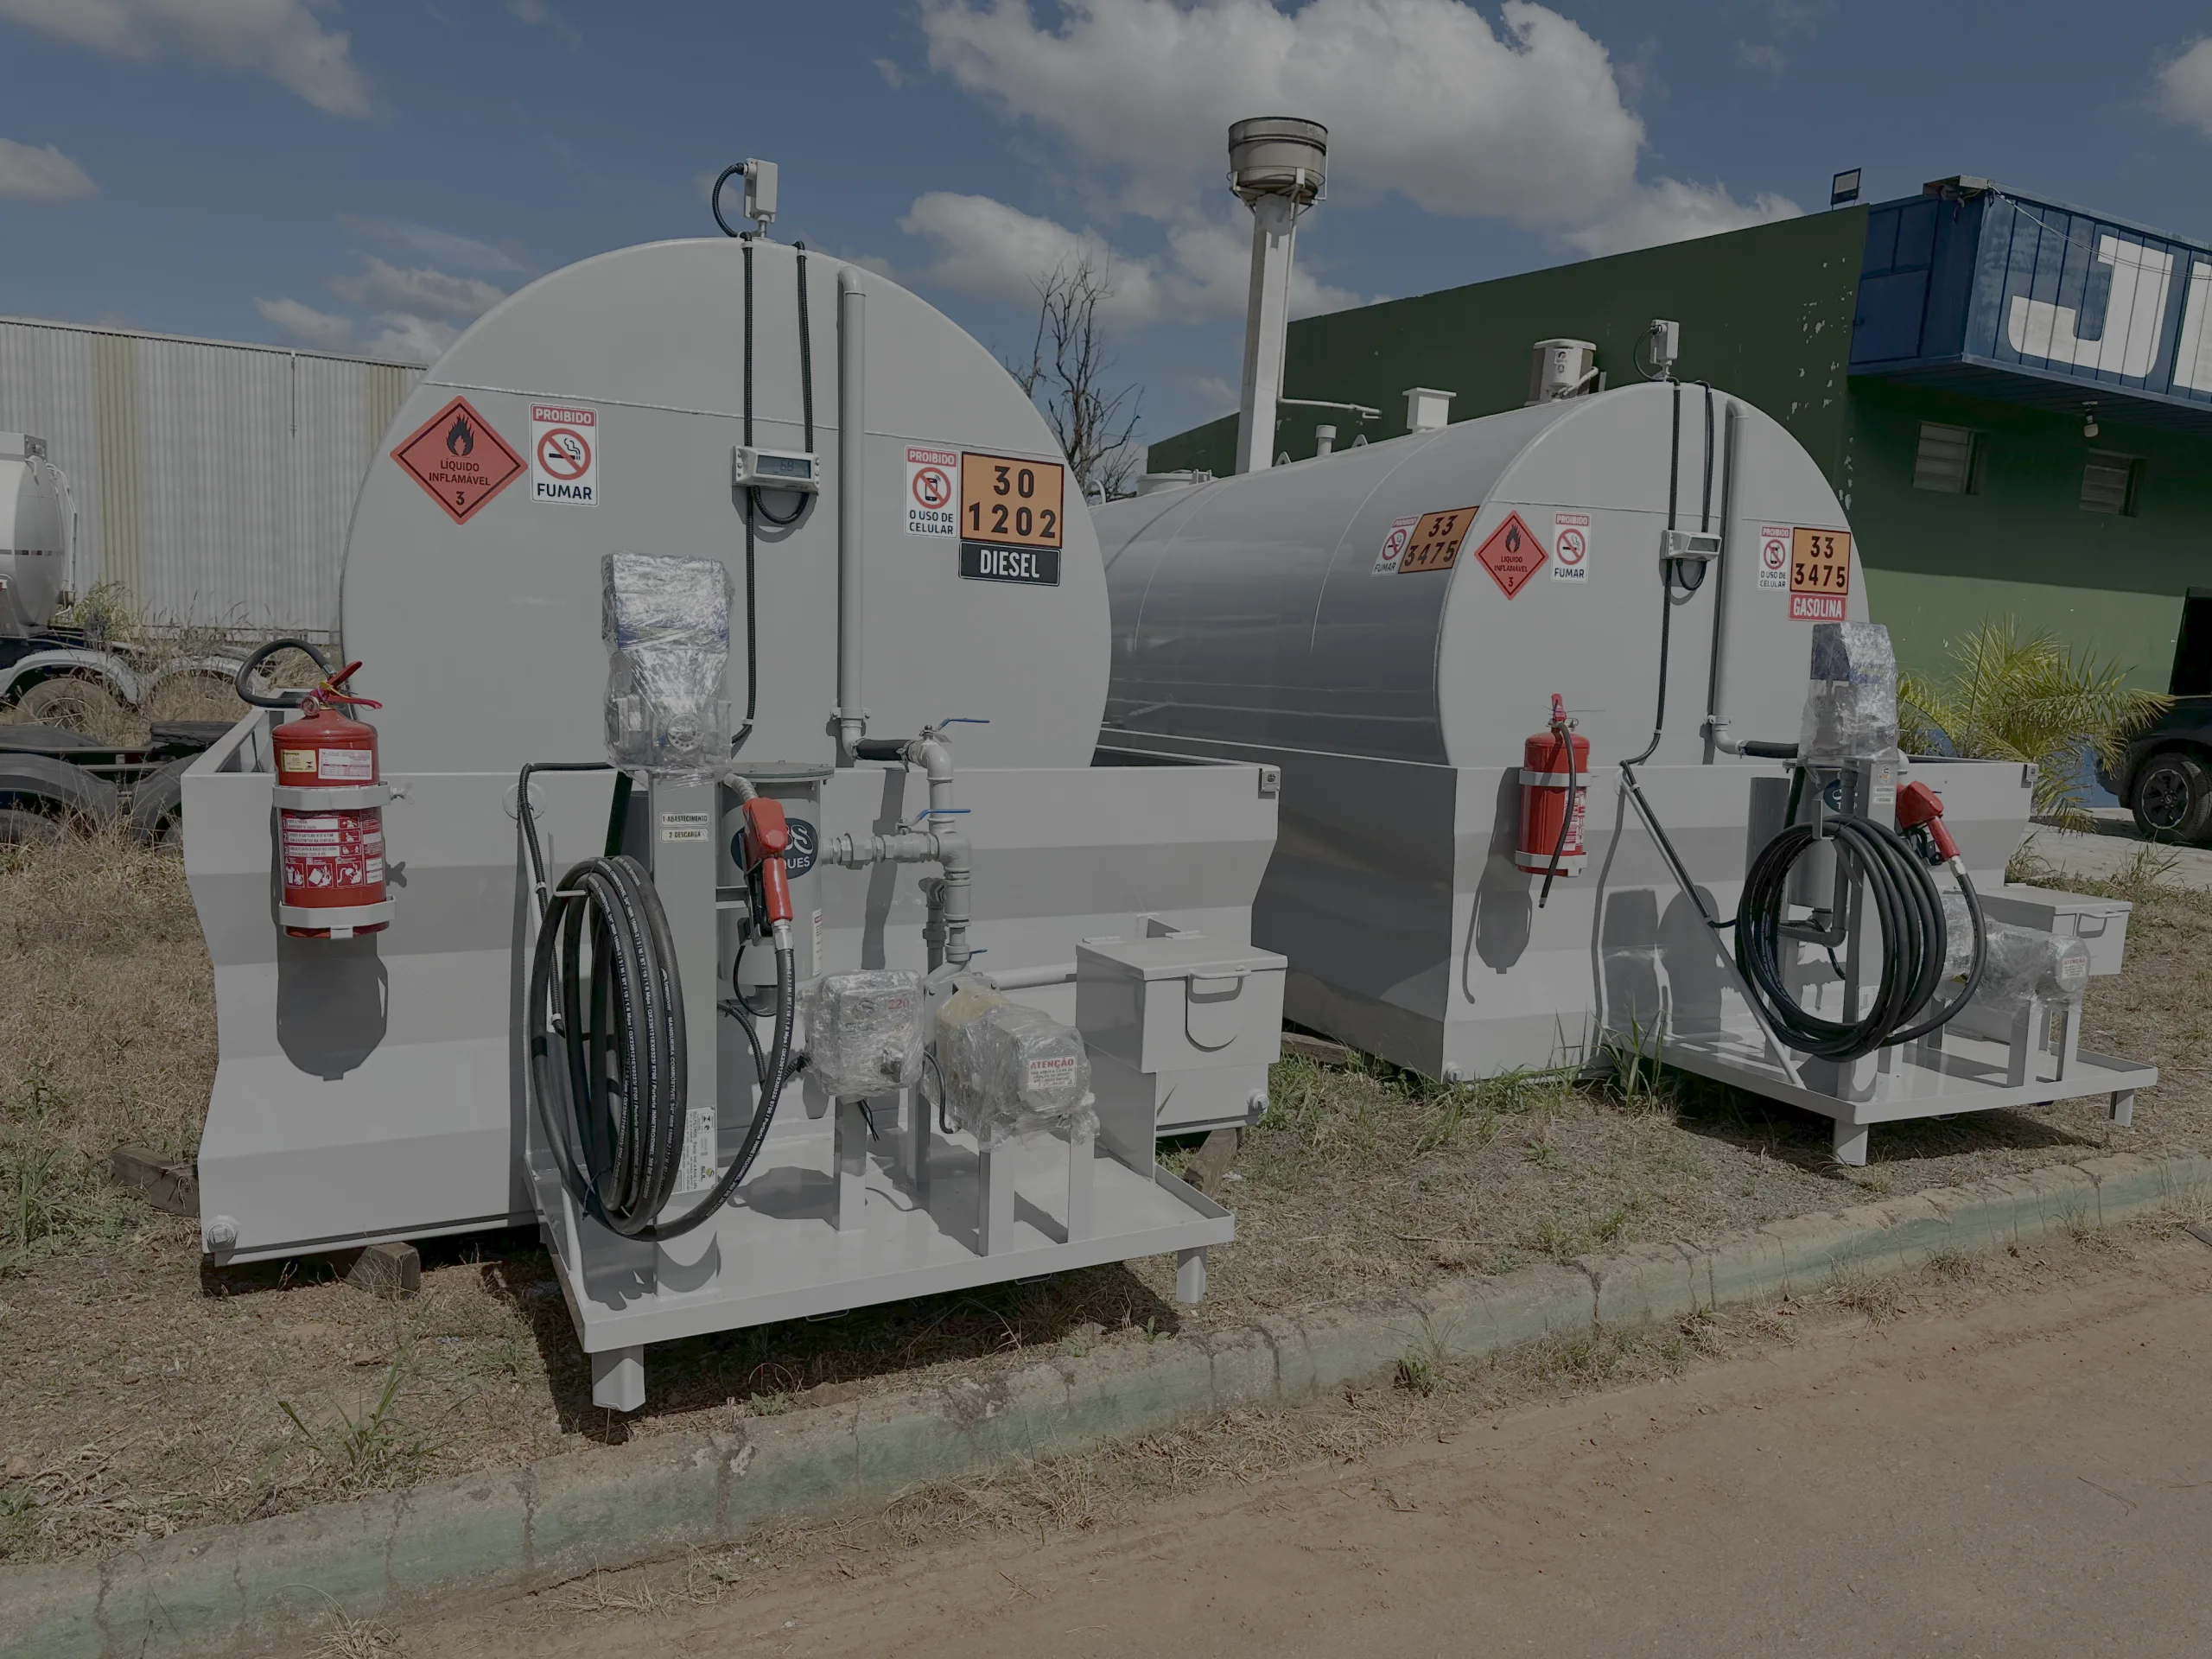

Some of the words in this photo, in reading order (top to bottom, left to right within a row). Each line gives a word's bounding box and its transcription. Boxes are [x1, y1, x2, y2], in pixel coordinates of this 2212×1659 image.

[536, 408, 592, 424] PROIBIDO
[440, 457, 480, 473] LÍQUIDO
[909, 450, 955, 465] PROIBIDO
[429, 472, 491, 486] INFLAMÁVEL
[994, 465, 1034, 499] 30
[455, 491, 465, 505] 3
[537, 482, 592, 500] FUMAR
[909, 510, 916, 519] O
[918, 511, 938, 522] USO
[941, 512, 953, 523] DE
[969, 501, 1057, 538] 1202
[1556, 514, 1588, 526] PROIBIDO
[909, 522, 954, 535] CELULAR
[1428, 515, 1459, 537] 33
[1763, 528, 1789, 537] PROIBIDO
[1404, 540, 1459, 566] 3475
[1810, 536, 1834, 559] 33
[980, 549, 1040, 578] DIESEL
[1374, 563, 1396, 572] FUMAR
[1554, 568, 1585, 578] FUMAR
[1794, 563, 1846, 588] 3475
[1508, 576, 1514, 588] 3
[1760, 580, 1786, 588] CELULAR
[1793, 597, 1842, 618] GASOLINA
[1030, 1057, 1074, 1069] ATENÇÃO
